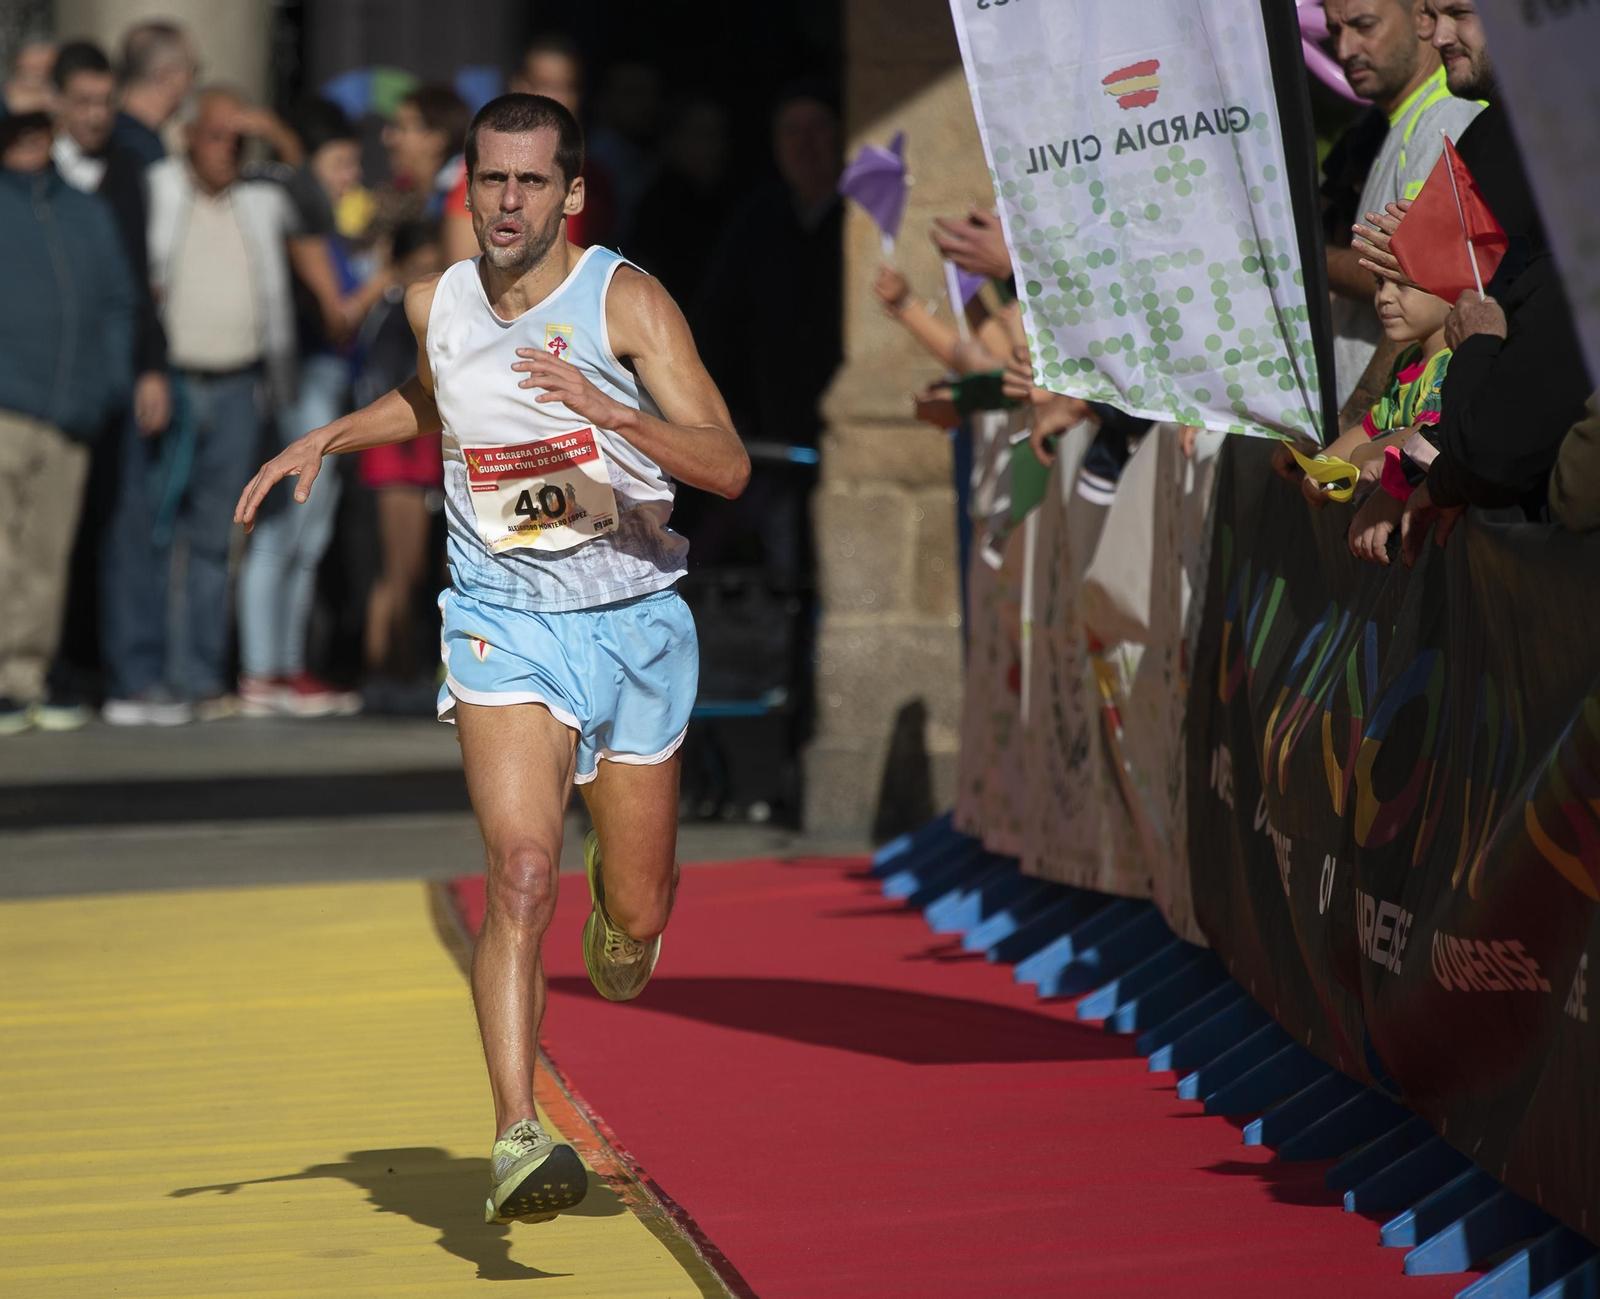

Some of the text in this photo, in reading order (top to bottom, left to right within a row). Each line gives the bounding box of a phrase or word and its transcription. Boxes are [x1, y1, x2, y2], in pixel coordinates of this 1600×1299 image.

[478, 445, 592, 474] GUARDIA CIVIL DE OURENSE
[484, 438, 578, 462] III CARRERA DEL PILAR
[514, 485, 567, 521] 40
[539, 518, 568, 530] MONTERO
[568, 510, 588, 523] LOPEZ
[1431, 929, 1552, 993] OURENSE
